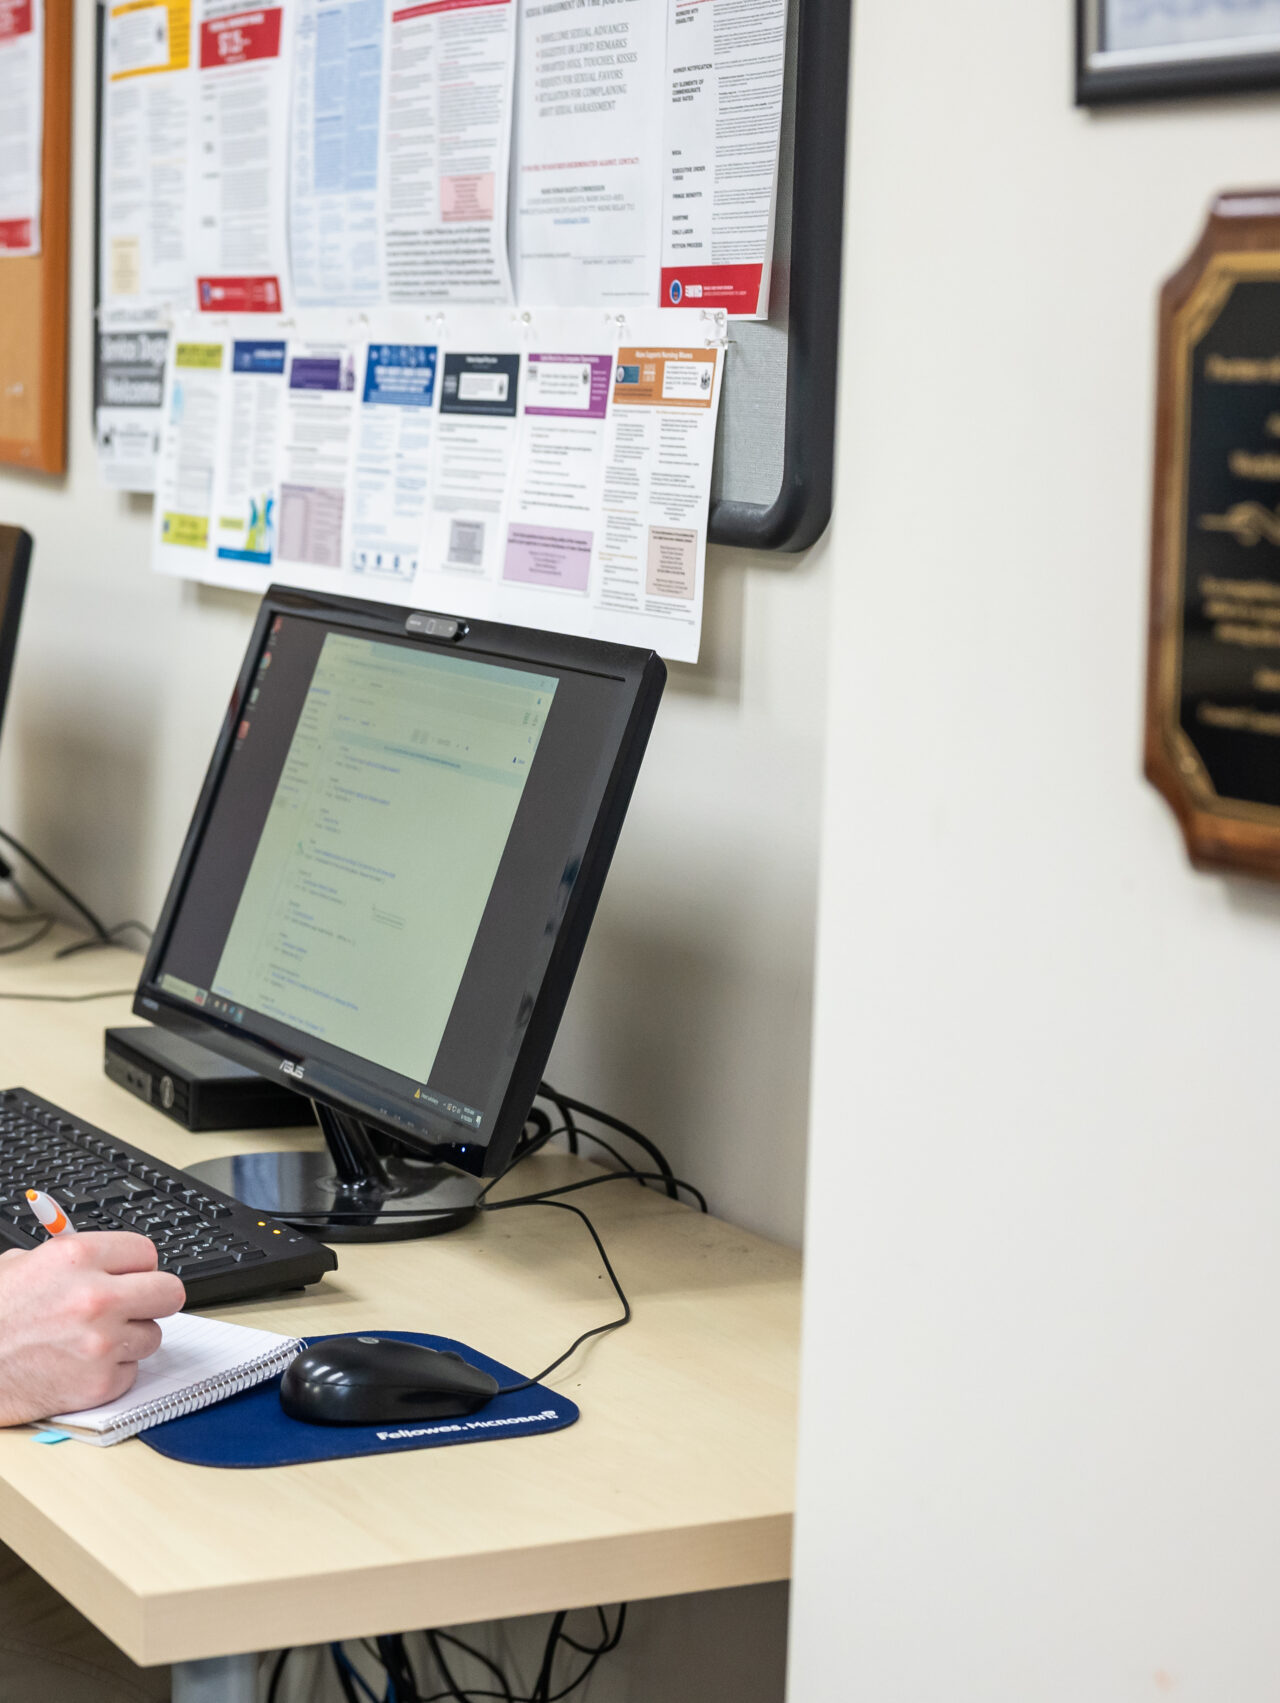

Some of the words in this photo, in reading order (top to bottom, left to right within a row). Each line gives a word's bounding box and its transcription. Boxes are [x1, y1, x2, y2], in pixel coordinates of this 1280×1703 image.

[594, 22, 630, 36] ADVANCES
[596, 38, 628, 51] REMARKS
[616, 52, 639, 64] KISSES
[598, 69, 624, 81] FAVORS
[583, 84, 628, 98] COMPLAINING
[574, 100, 616, 113] HARASSMENT
[279, 1059, 305, 1079] ASUS
